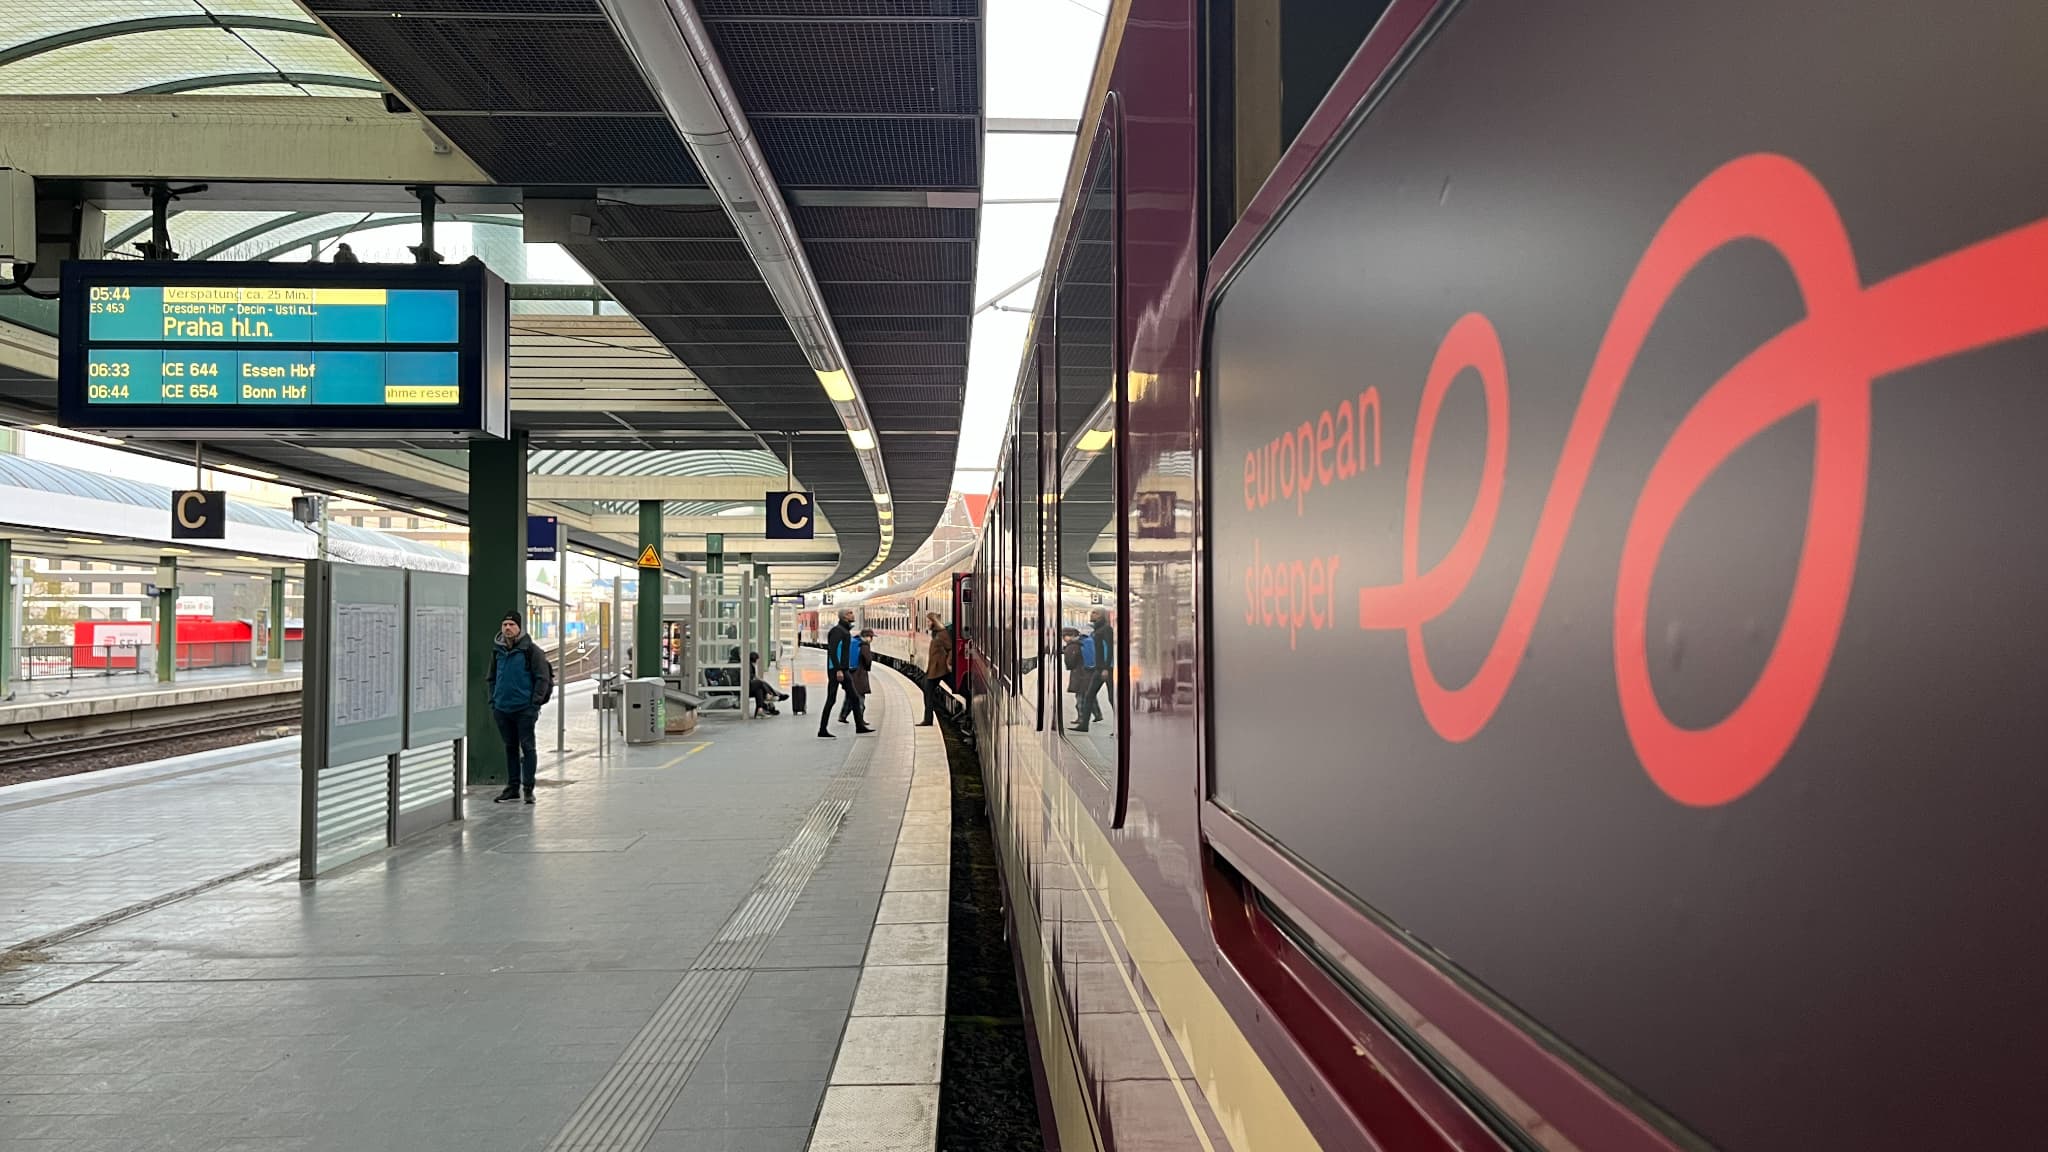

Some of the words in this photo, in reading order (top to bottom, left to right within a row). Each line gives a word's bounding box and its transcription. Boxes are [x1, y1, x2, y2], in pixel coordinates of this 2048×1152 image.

[91, 287, 131, 301] 05:44
[246, 291, 263, 299] ca.
[268, 290, 281, 299] 25
[285, 290, 309, 299] Min.
[90, 303, 103, 313] ES
[106, 304, 125, 314] 453
[163, 303, 206, 314] Dresden
[208, 304, 226, 314] Hbf
[164, 316, 224, 337] Praha
[231, 317, 273, 337] hl.n.
[89, 363, 130, 377] 06:33
[162, 362, 185, 377] ICE
[189, 363, 218, 377] 644
[242, 363, 285, 377] Essen
[290, 363, 316, 377] Hbf
[89, 384, 130, 399] 06:44
[162, 384, 185, 398] ICE
[189, 384, 218, 398] 654
[242, 384, 277, 399] Bonn
[282, 385, 307, 399] Hbf
[1243, 385, 1382, 517] european
[177, 491, 206, 529] C
[780, 492, 808, 529] C
[1245, 537, 1340, 651] sleeper
